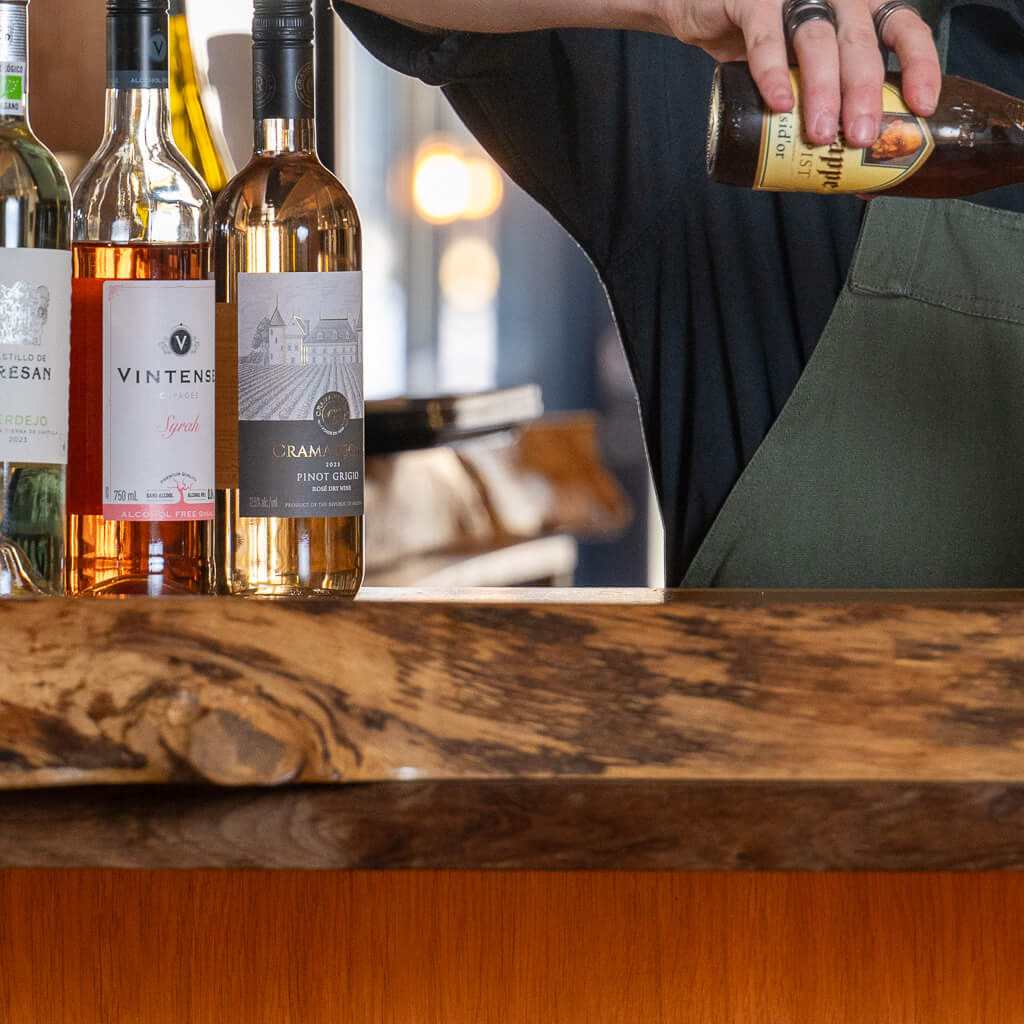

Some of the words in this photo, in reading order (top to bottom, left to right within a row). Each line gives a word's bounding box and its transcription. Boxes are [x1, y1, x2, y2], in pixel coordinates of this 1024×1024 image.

[776, 112, 793, 161] sid'or
[816, 135, 846, 189] appe
[0, 352, 34, 362] STILLO
[158, 415, 200, 440] Syrah
[296, 472, 330, 482] PINOT
[332, 471, 360, 481] GRIGIO
[120, 510, 170, 519] ALCOHOL
[175, 510, 197, 519] FREE
